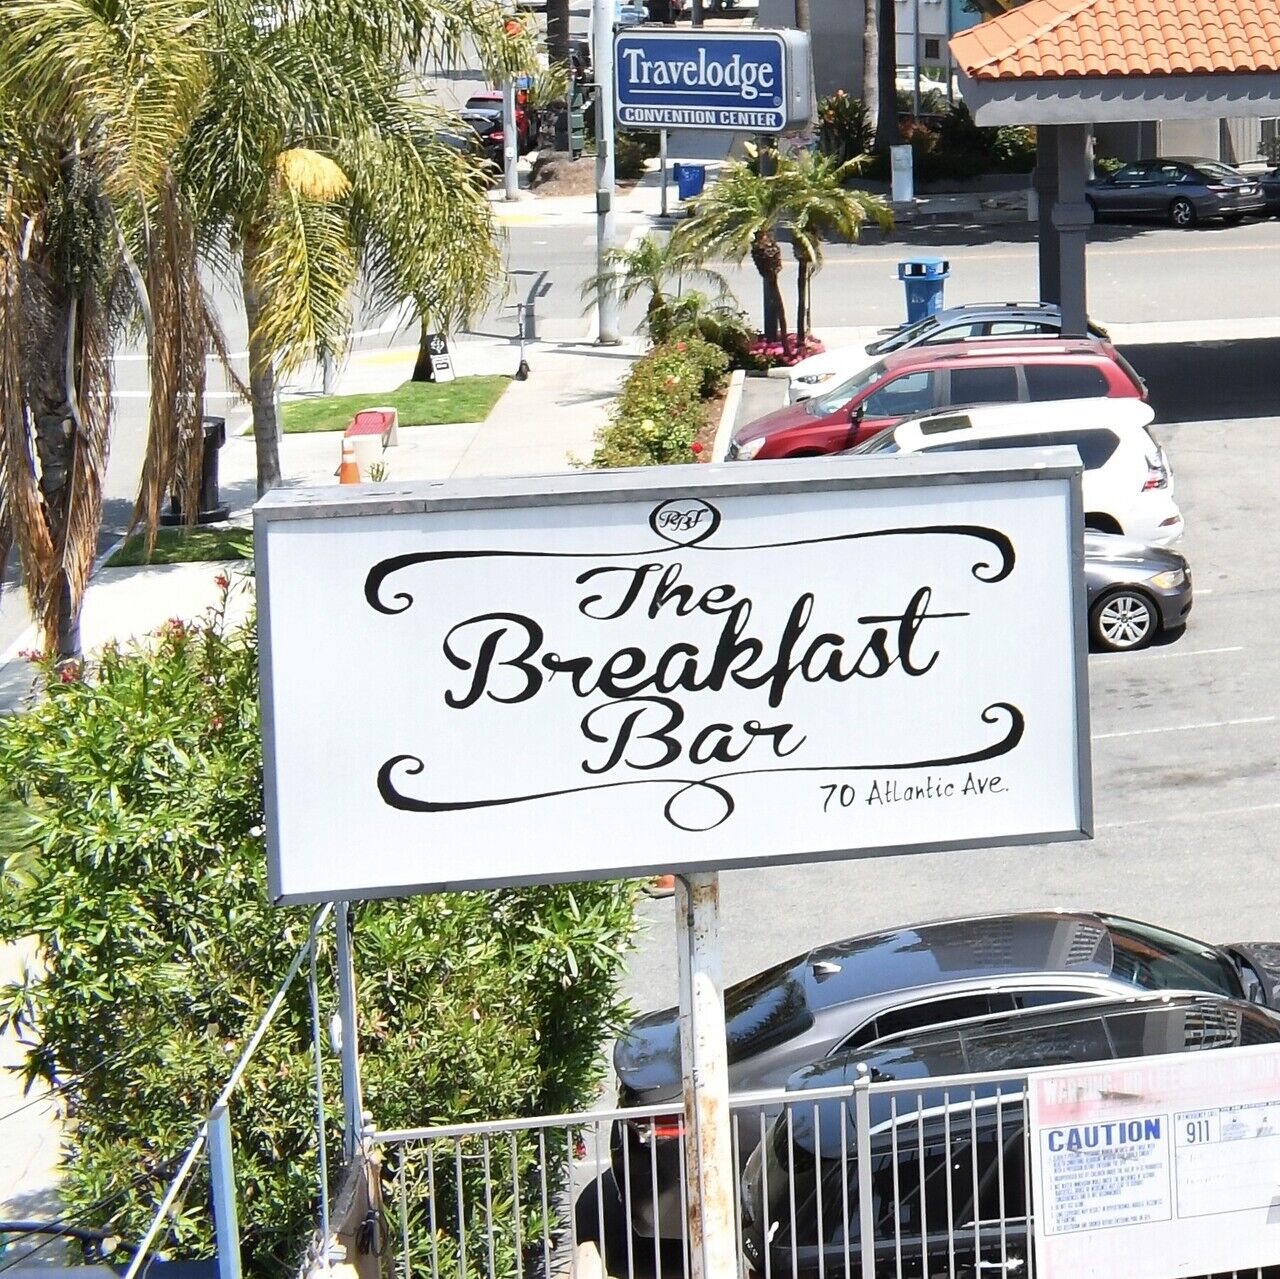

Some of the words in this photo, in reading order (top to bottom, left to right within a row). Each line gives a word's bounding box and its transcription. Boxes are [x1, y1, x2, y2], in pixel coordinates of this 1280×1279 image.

[622, 48, 774, 100] Travelodge
[625, 108, 717, 124] CONVENTION
[720, 111, 776, 127] CENTER
[576, 562, 735, 621] The
[443, 585, 970, 710] Breakfast
[581, 696, 807, 775] Bar
[820, 783, 856, 813] 70
[961, 772, 1009, 796] Ave.
[1048, 1118, 1161, 1152] CAUTION
[1186, 1119, 1210, 1144] 911
